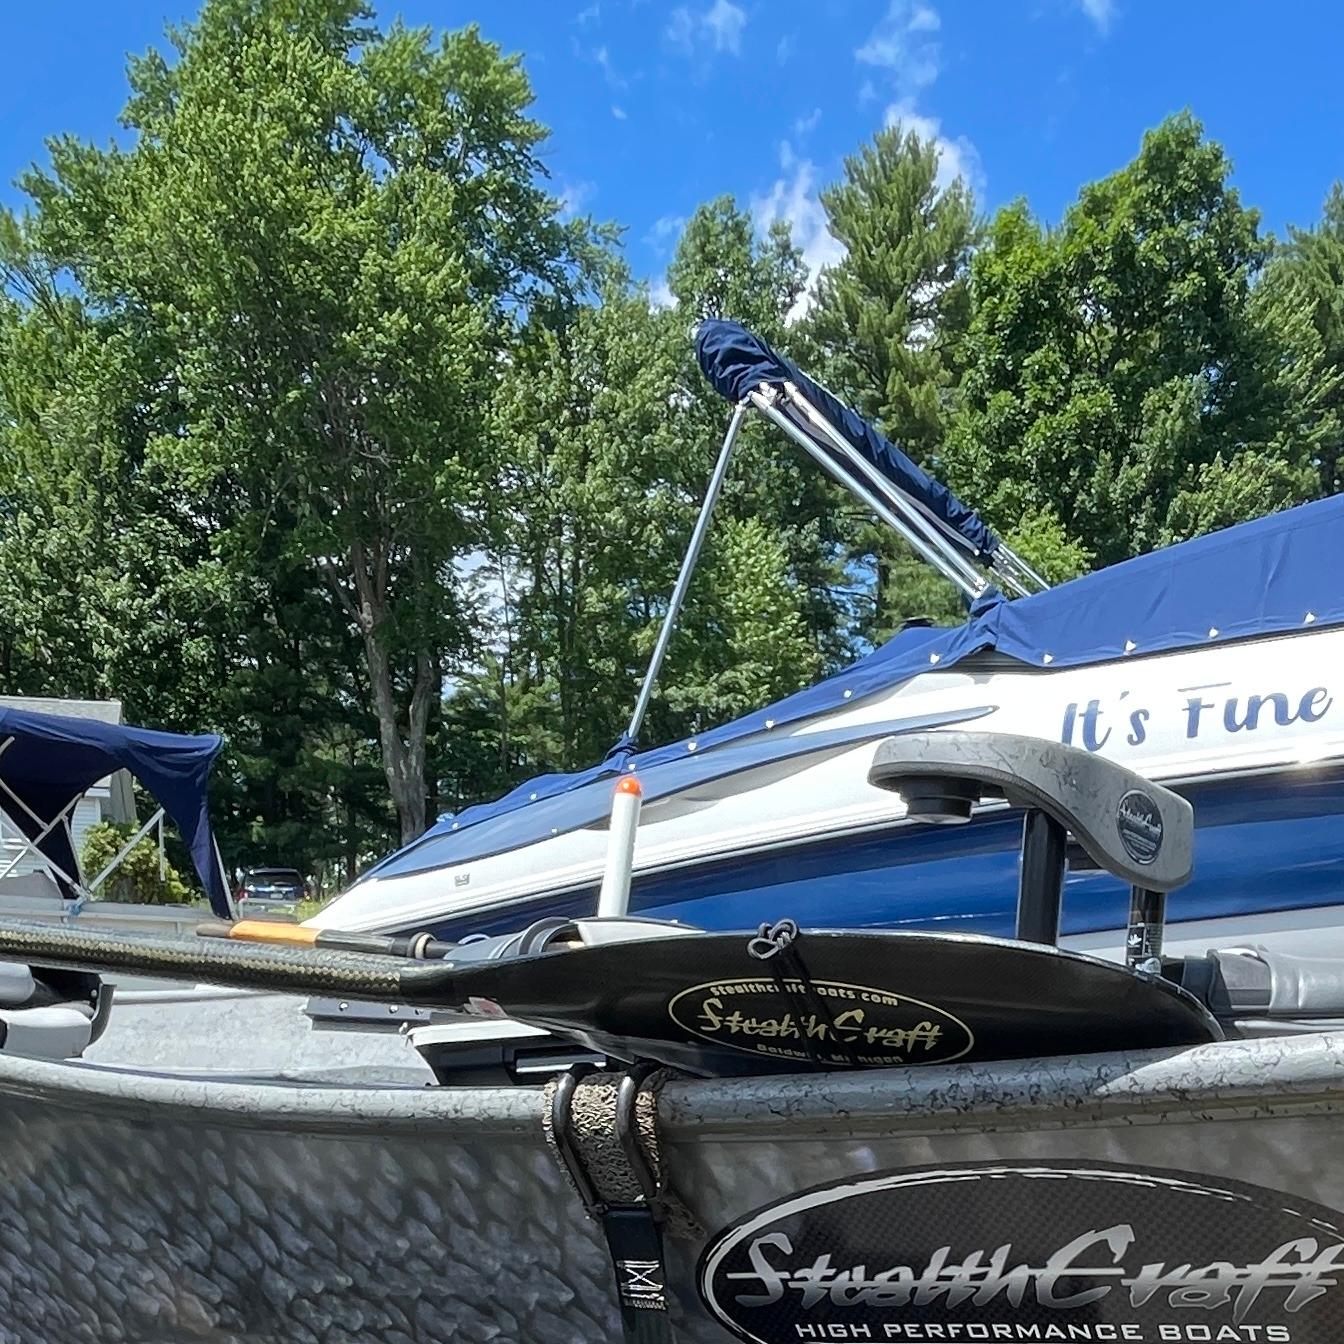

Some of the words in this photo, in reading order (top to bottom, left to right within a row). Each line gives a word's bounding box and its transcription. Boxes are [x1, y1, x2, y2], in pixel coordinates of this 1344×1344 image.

[1061, 690, 1150, 751] It's
[1177, 682, 1334, 739] Fine
[794, 1323, 872, 1338] HIGH
[883, 1323, 1144, 1341] PERFORMANCE
[1158, 1324, 1291, 1342] BOATS
